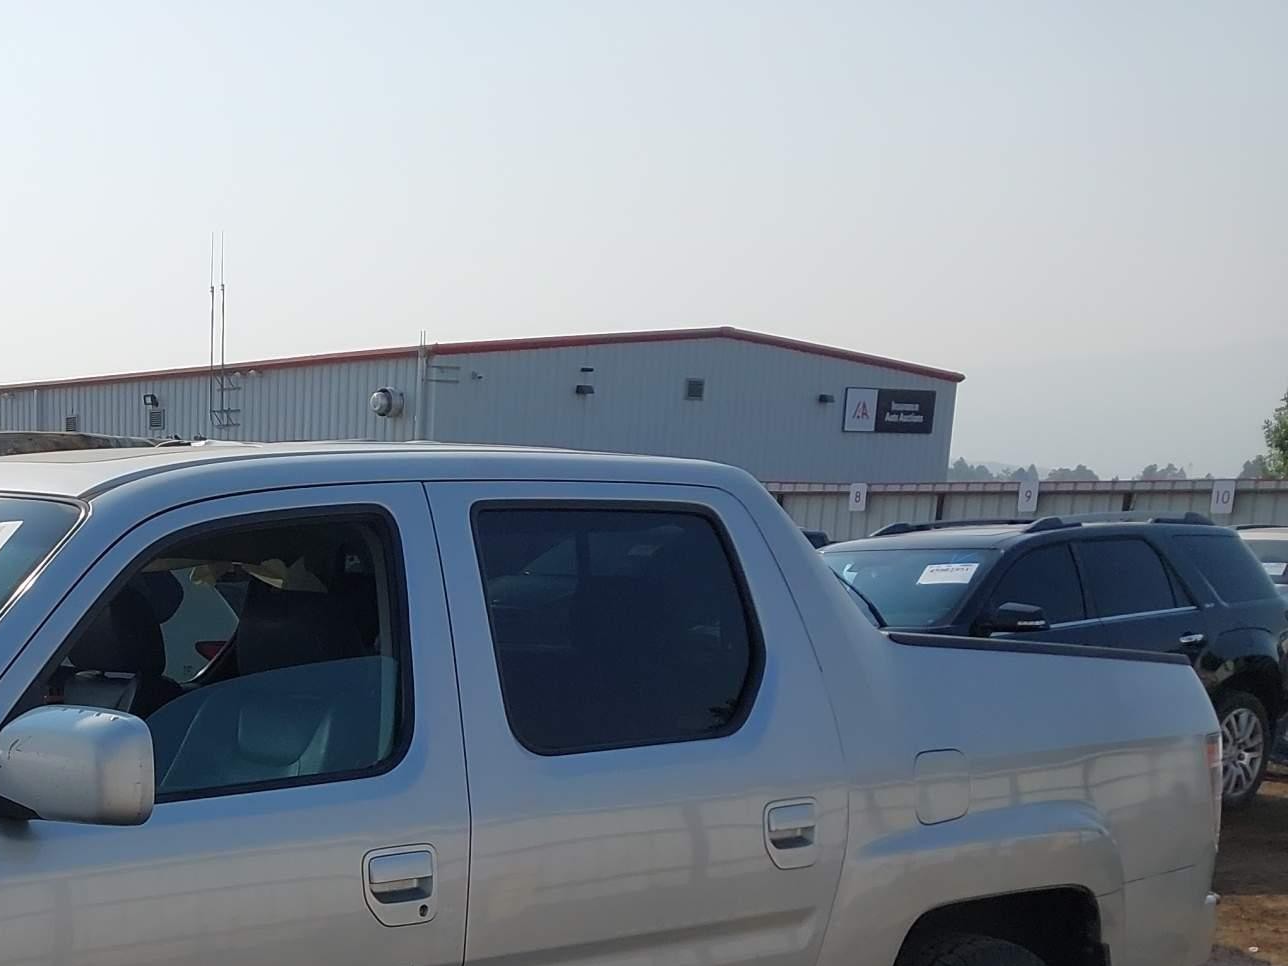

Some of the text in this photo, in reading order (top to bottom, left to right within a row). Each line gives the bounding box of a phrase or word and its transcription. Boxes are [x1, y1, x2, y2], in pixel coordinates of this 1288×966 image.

[854, 491, 861, 503] 8
[1024, 490, 1032, 501] 9
[1215, 490, 1230, 504] 10
